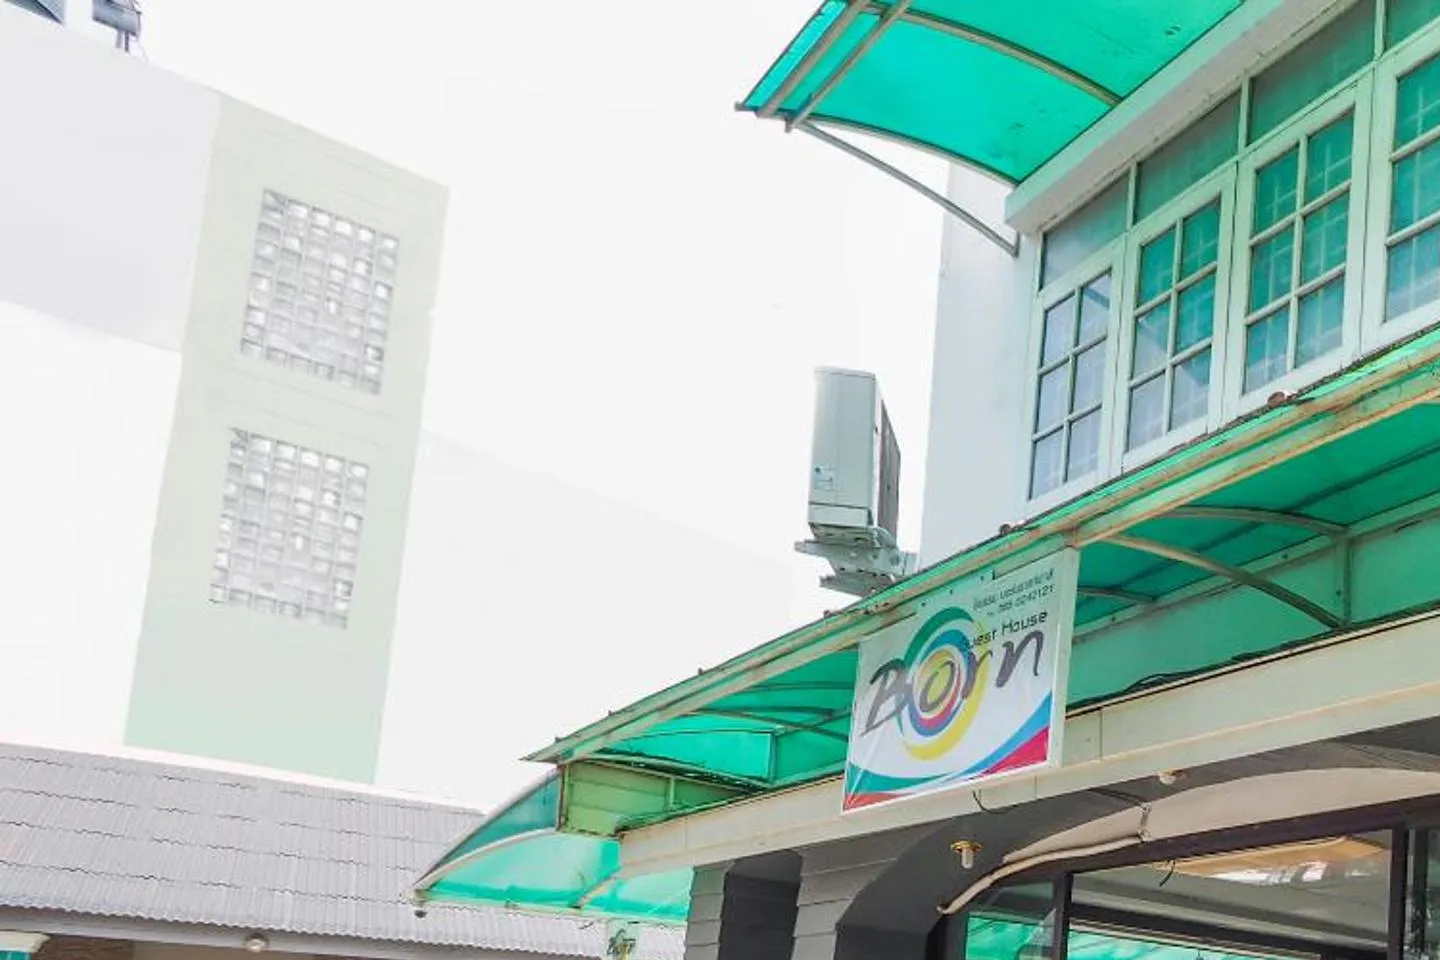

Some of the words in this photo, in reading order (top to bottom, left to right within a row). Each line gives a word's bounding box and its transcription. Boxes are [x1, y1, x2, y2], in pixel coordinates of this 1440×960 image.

[967, 629, 998, 649] uest
[1001, 611, 1048, 635] House
[862, 631, 1044, 736] Born
